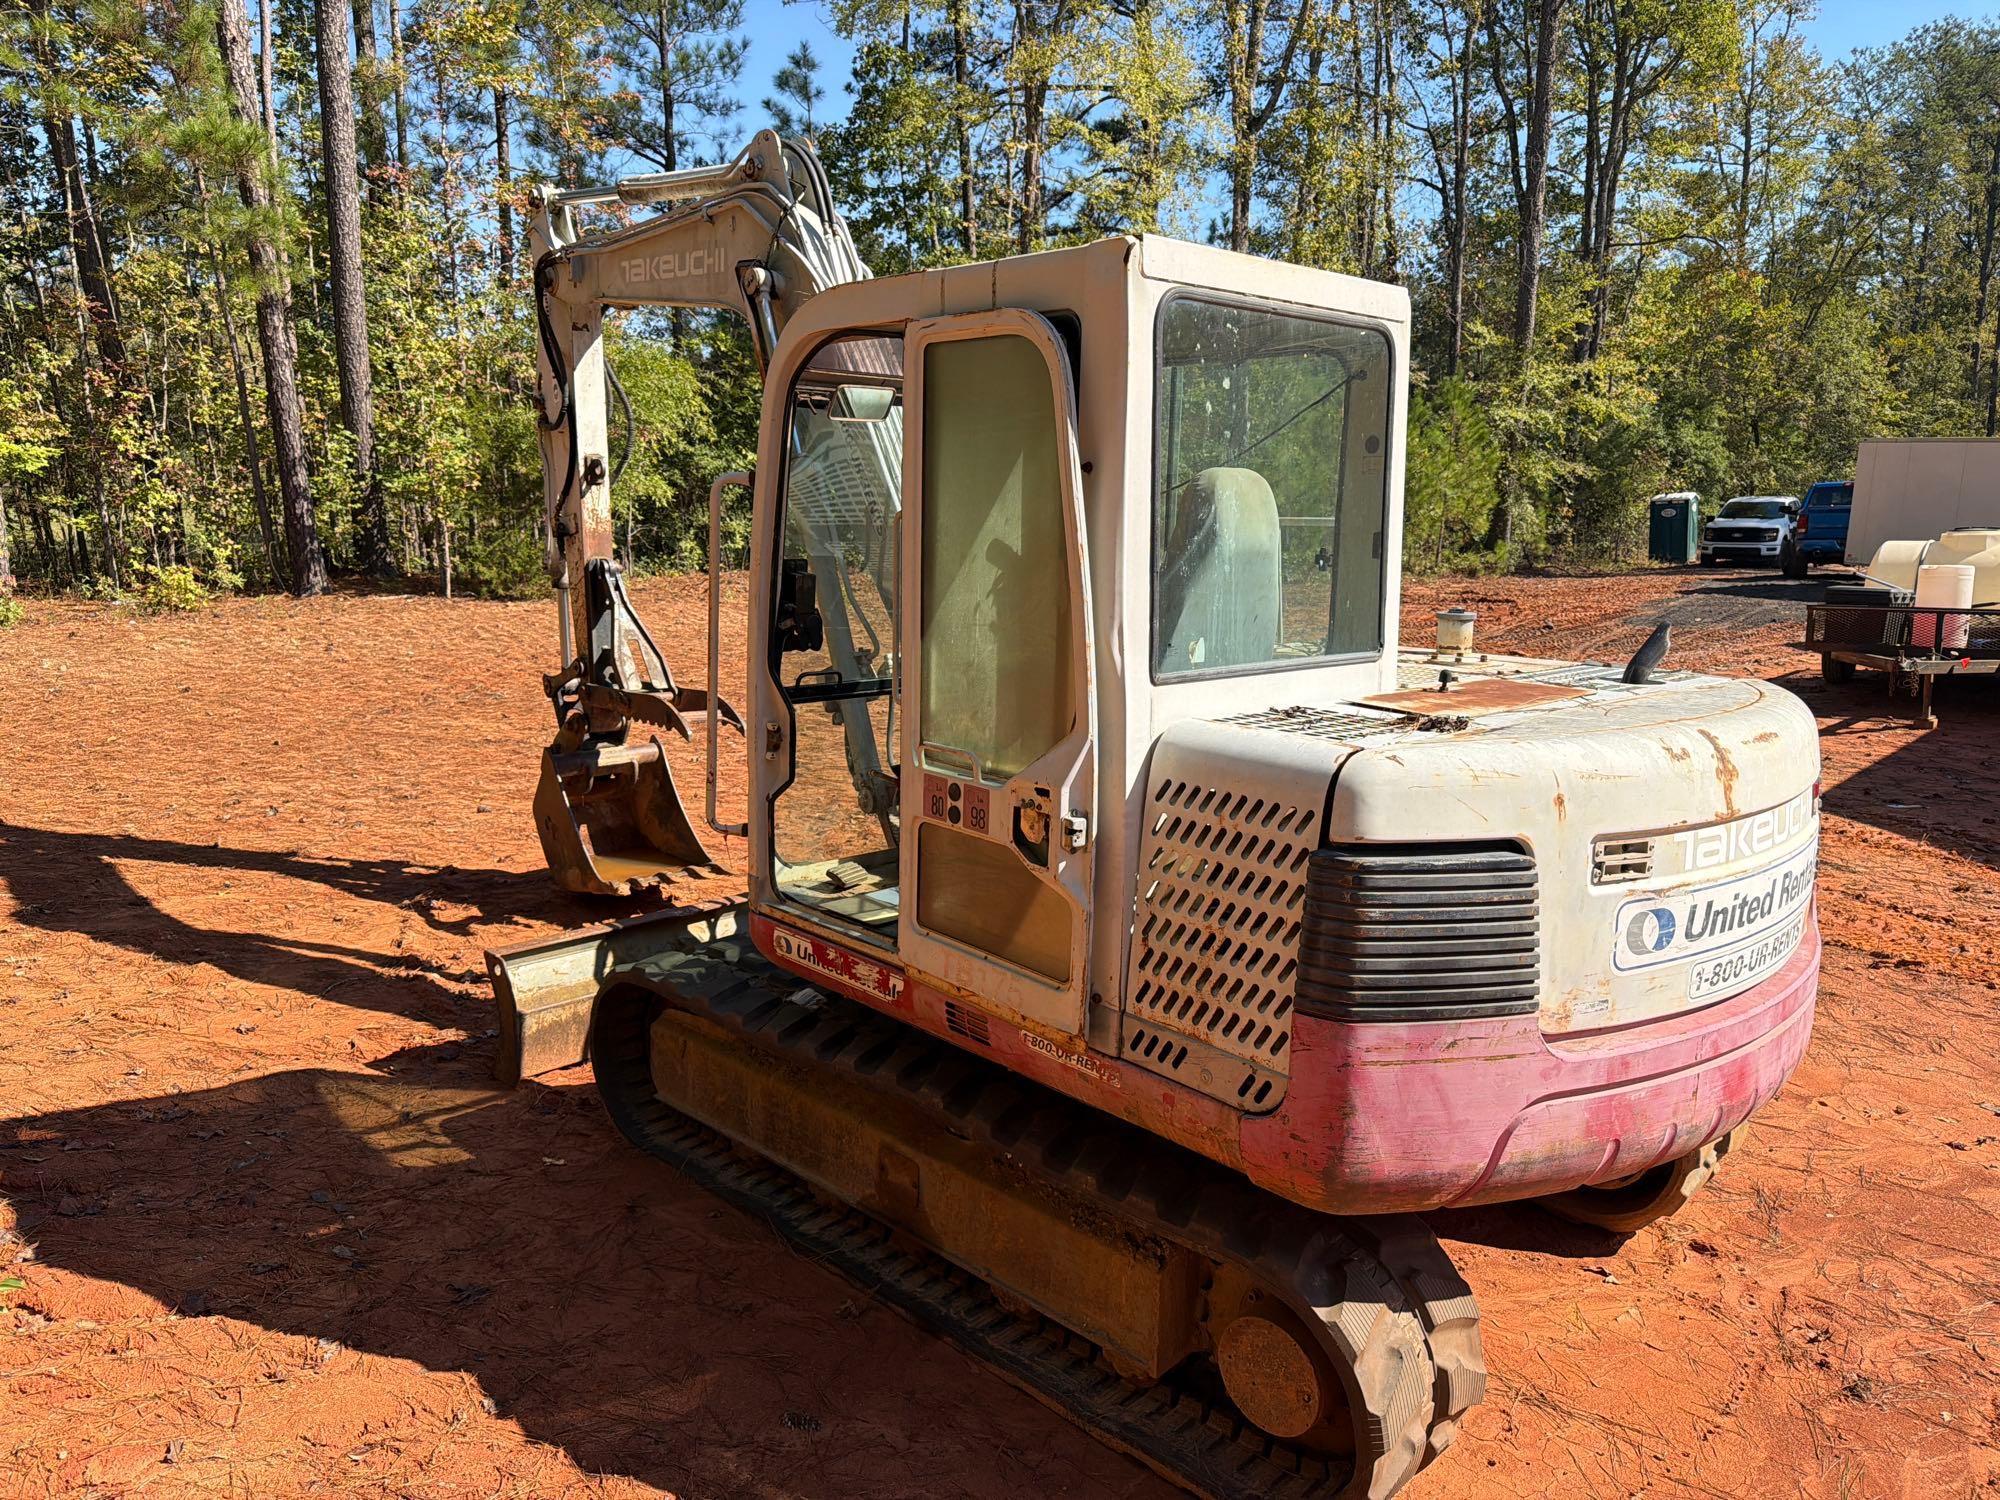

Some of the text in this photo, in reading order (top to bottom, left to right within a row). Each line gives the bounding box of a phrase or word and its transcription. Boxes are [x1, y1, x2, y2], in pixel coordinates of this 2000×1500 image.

[931, 794, 945, 817] 80
[970, 806, 986, 830] 98
[1684, 858, 1813, 942] United Renta
[1695, 921, 1801, 992] 1-800-UR-RENTS
